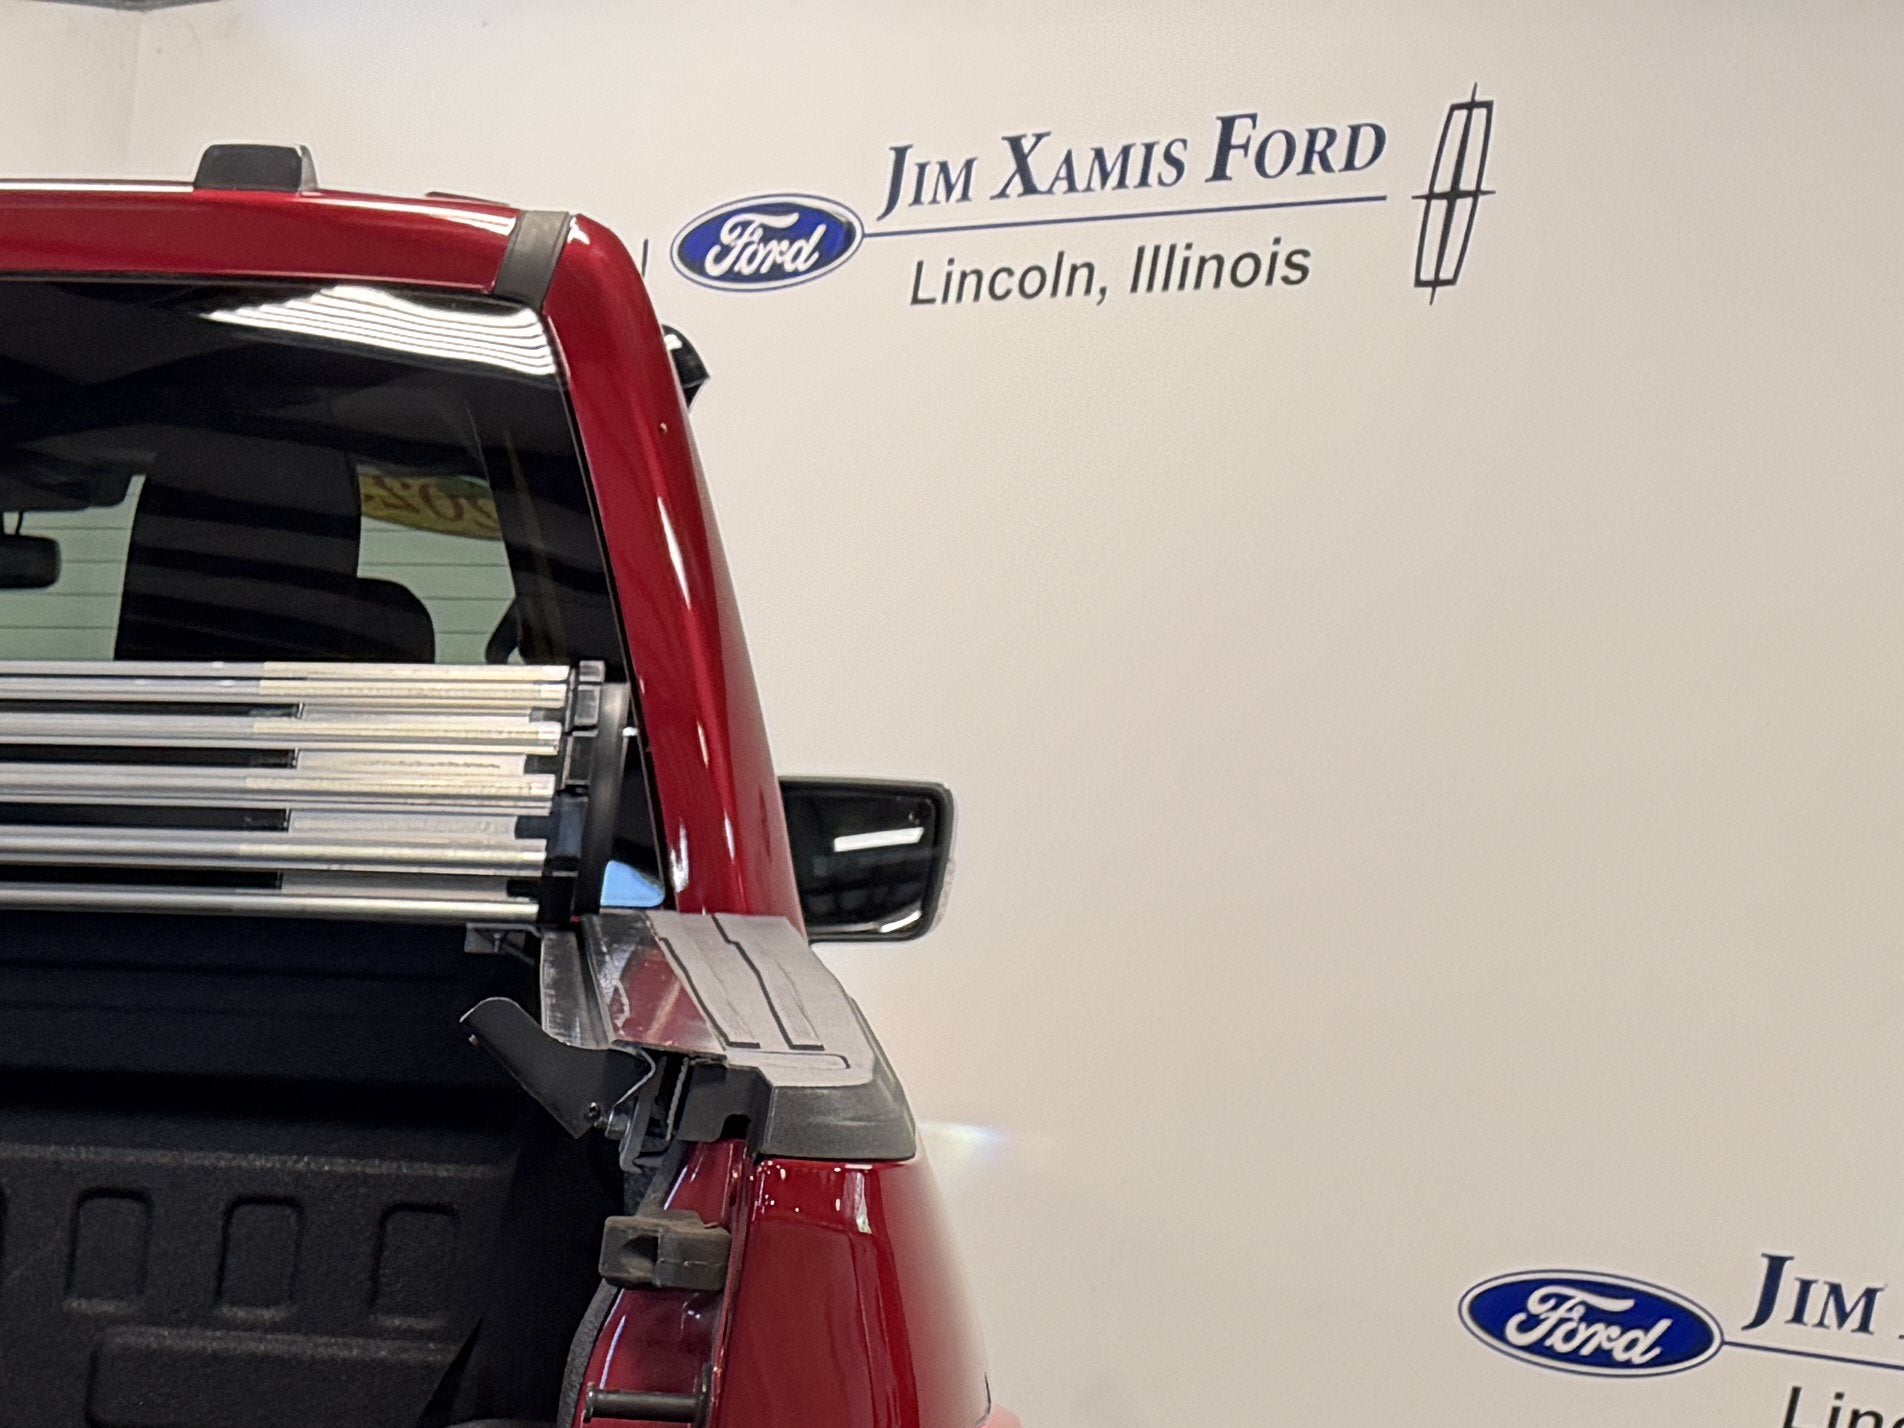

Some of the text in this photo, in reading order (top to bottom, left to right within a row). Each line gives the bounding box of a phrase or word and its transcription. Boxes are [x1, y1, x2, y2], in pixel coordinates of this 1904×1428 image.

[877, 112, 1388, 221] JIM XAMIS FORD
[703, 212, 827, 277] Ford
[910, 237, 1311, 306] Lincoln, Illinois
[1505, 1285, 1673, 1365] Ford
[1740, 1253, 1888, 1336] JIM
